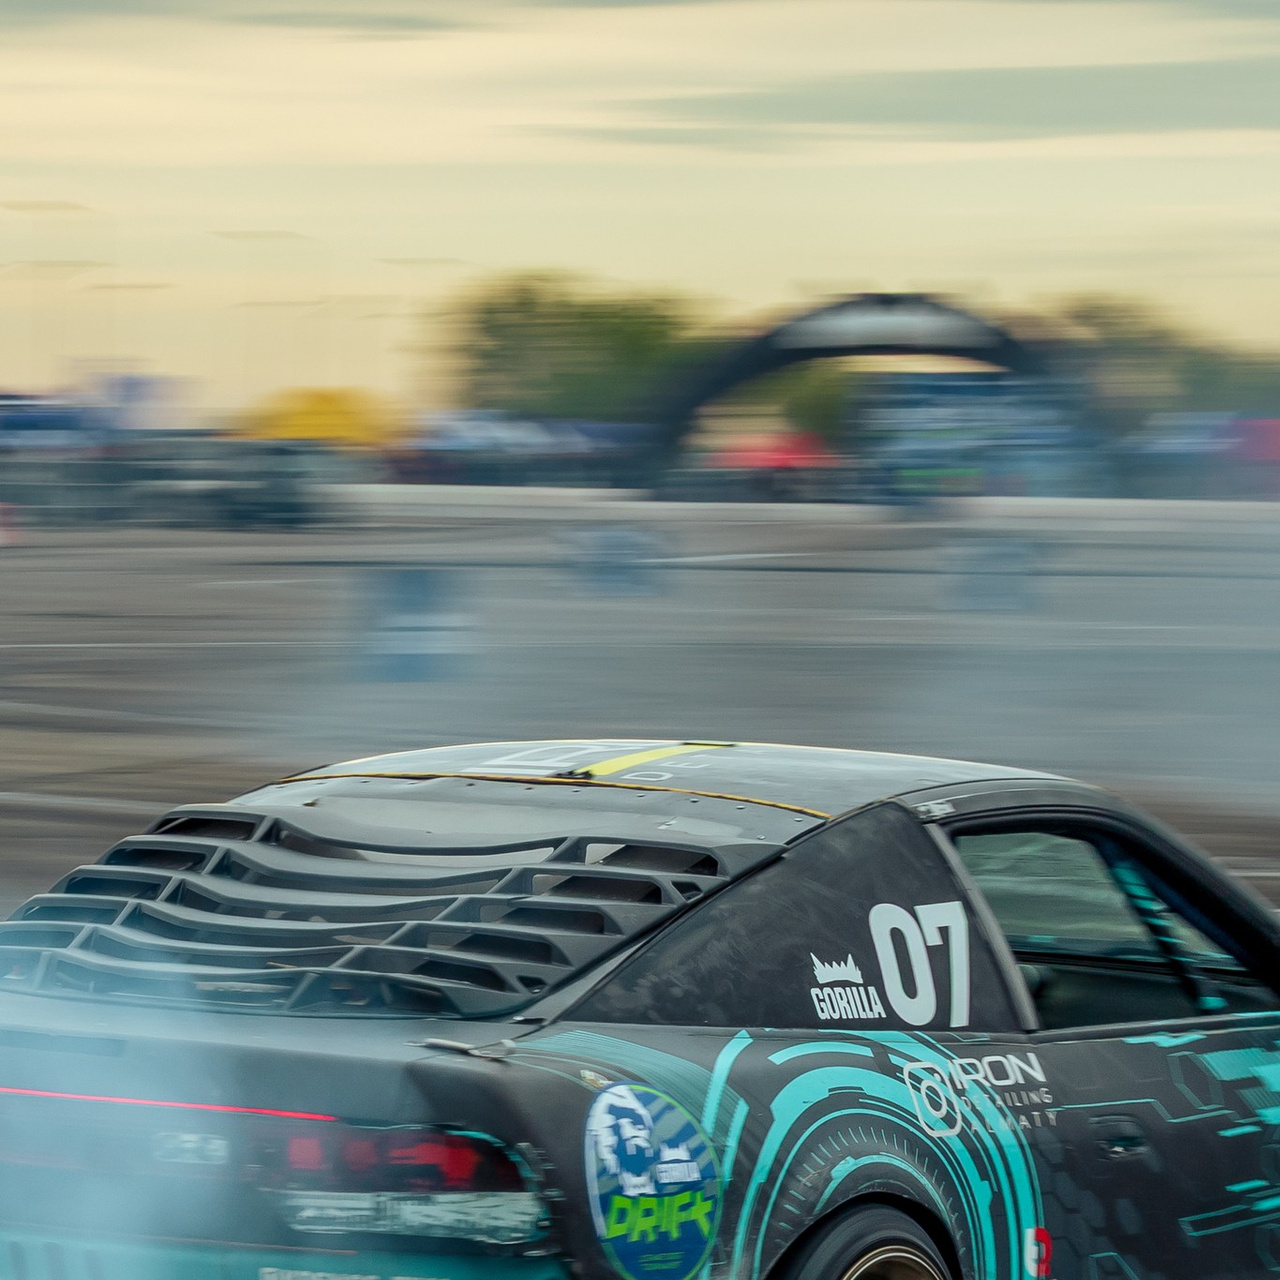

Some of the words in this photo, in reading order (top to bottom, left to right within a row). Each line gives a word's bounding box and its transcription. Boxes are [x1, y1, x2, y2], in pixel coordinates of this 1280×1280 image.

[868, 901, 969, 1028] 07
[810, 986, 887, 1020] GORILLA
[948, 1052, 1048, 1090] IRON
[604, 1190, 714, 1243] DRIFT
